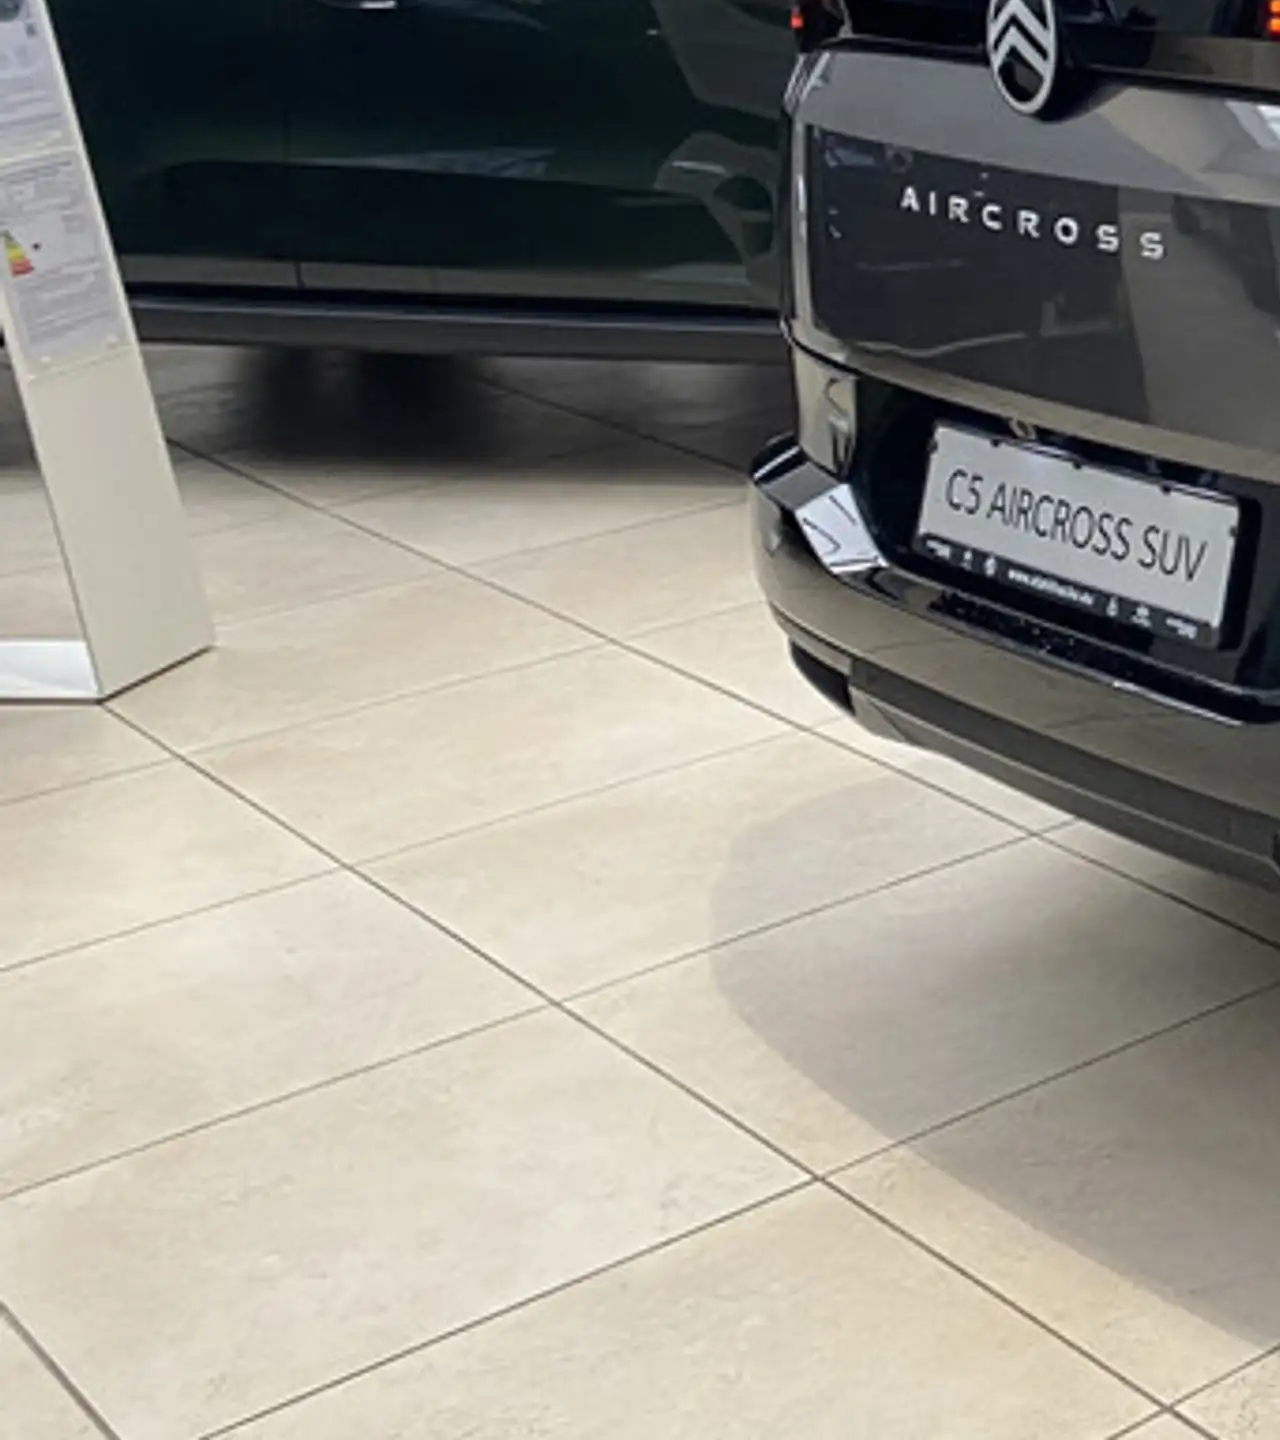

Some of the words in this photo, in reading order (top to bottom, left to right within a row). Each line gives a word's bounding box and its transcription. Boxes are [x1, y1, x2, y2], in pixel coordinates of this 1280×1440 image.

[900, 186, 1165, 260] AIRCROSS
[945, 468, 984, 515] C5
[986, 482, 1134, 561] AIRCROSS
[1137, 524, 1208, 583] SUV
